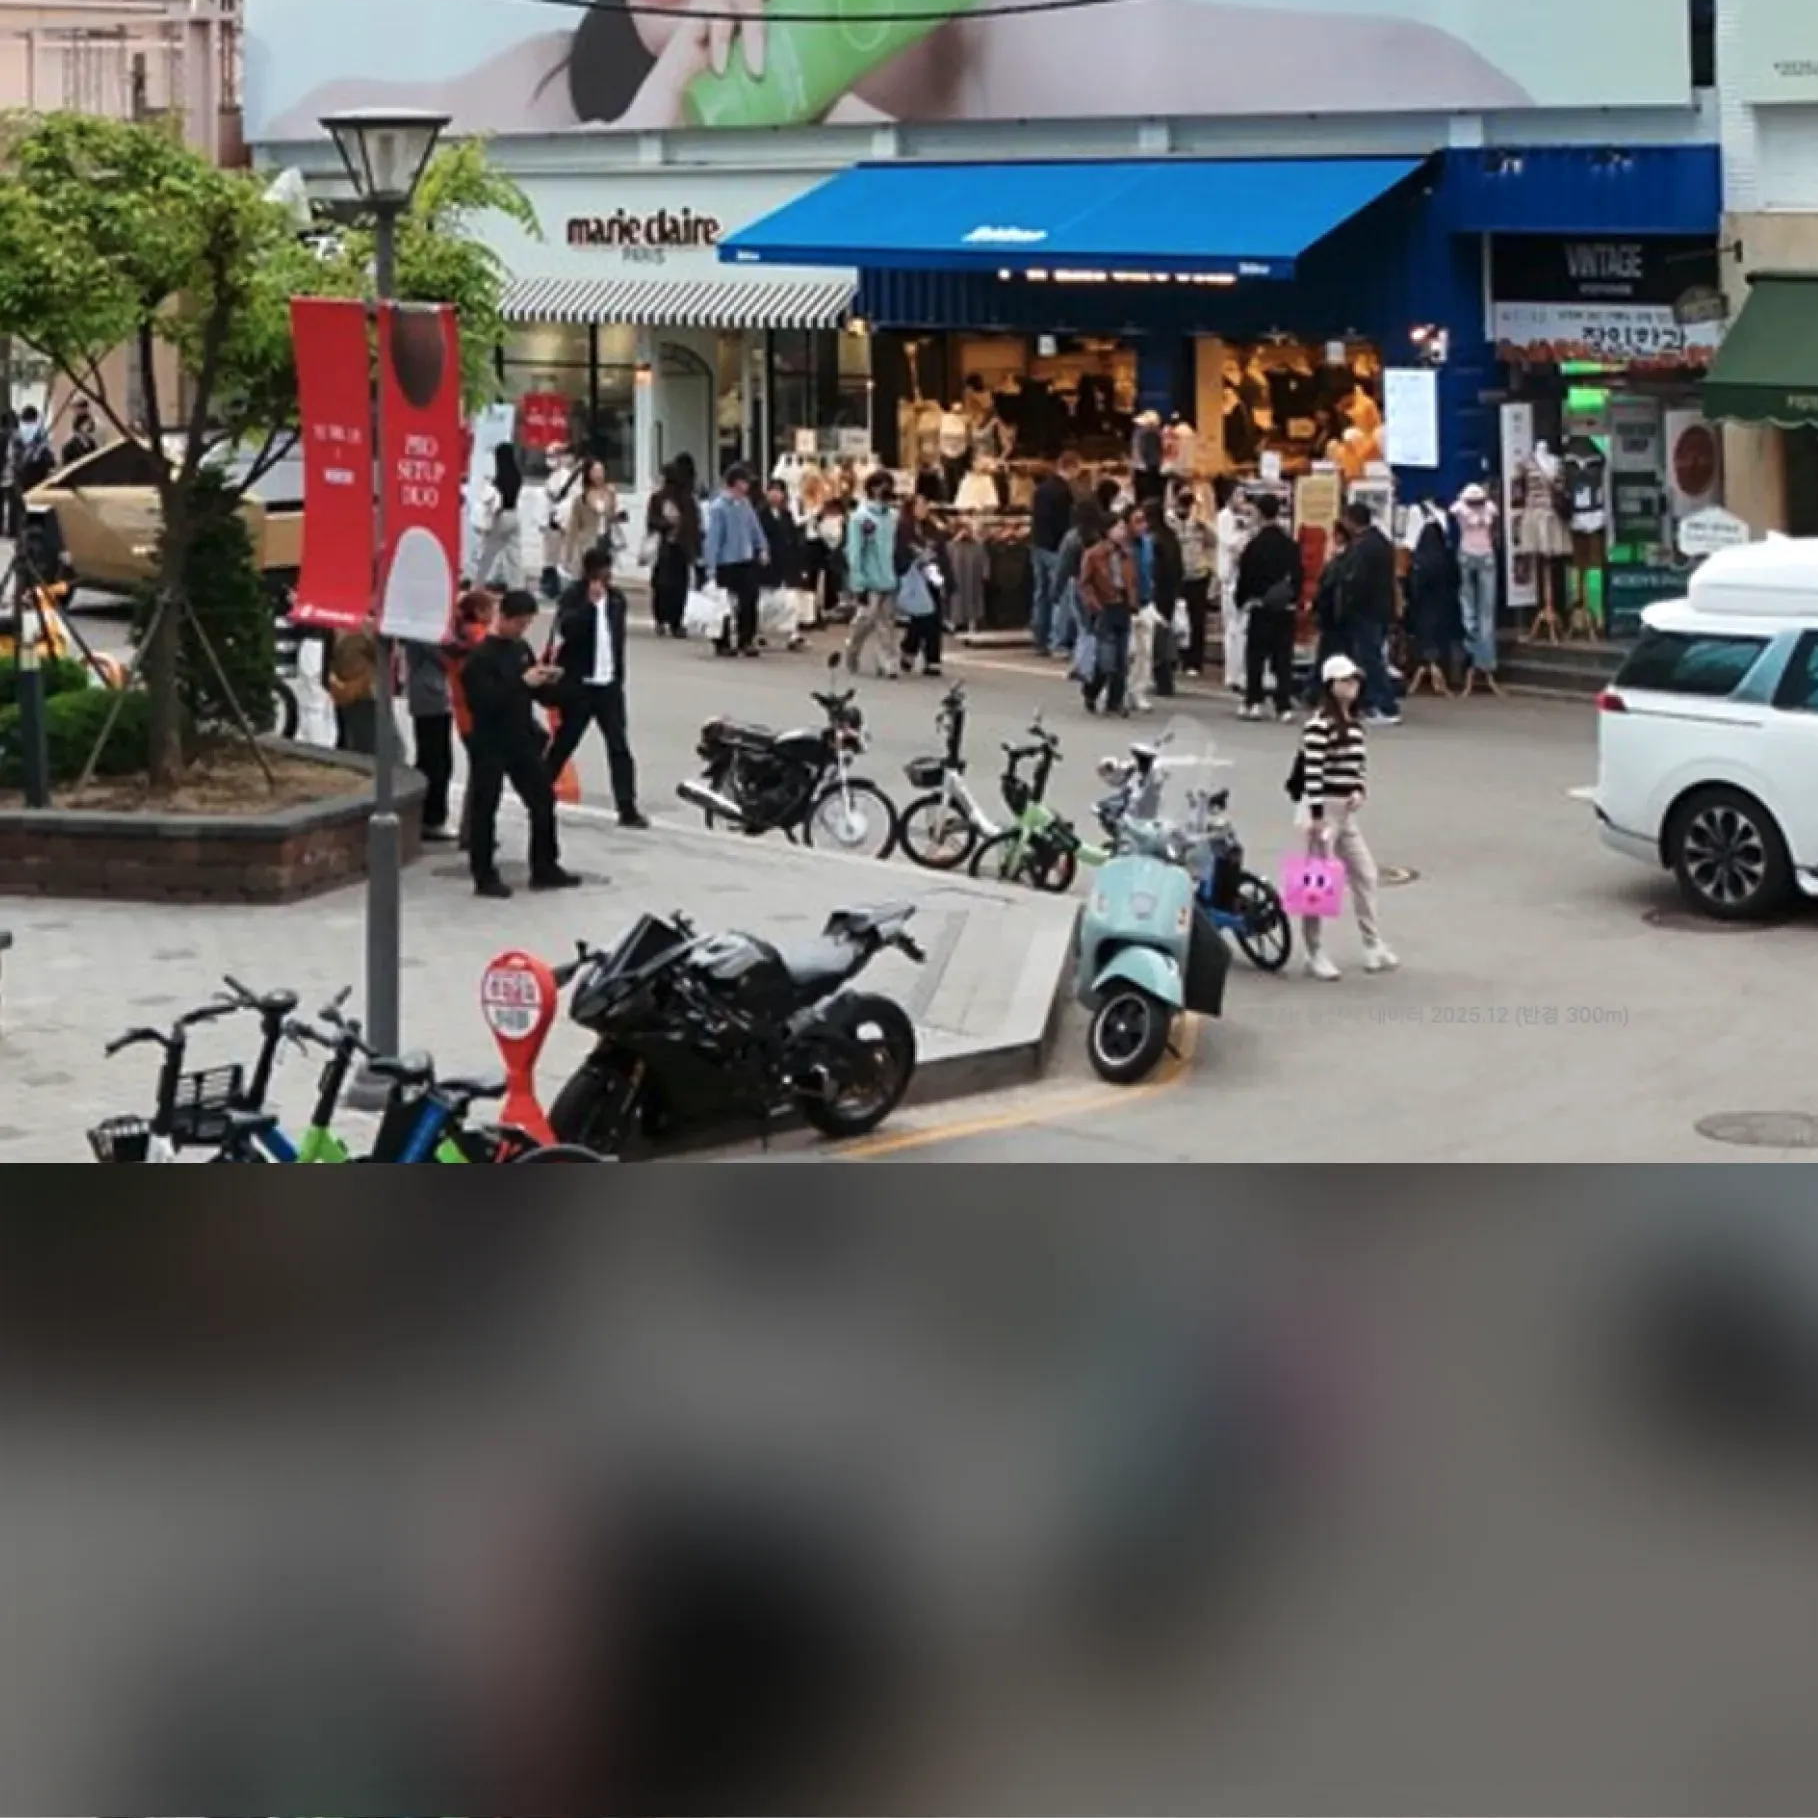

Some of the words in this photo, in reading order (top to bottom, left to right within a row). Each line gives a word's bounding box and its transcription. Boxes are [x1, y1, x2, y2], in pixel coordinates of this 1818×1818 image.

[567, 207, 641, 246] marie
[645, 207, 720, 246] claire
[1565, 243, 1643, 278] VINTAGE
